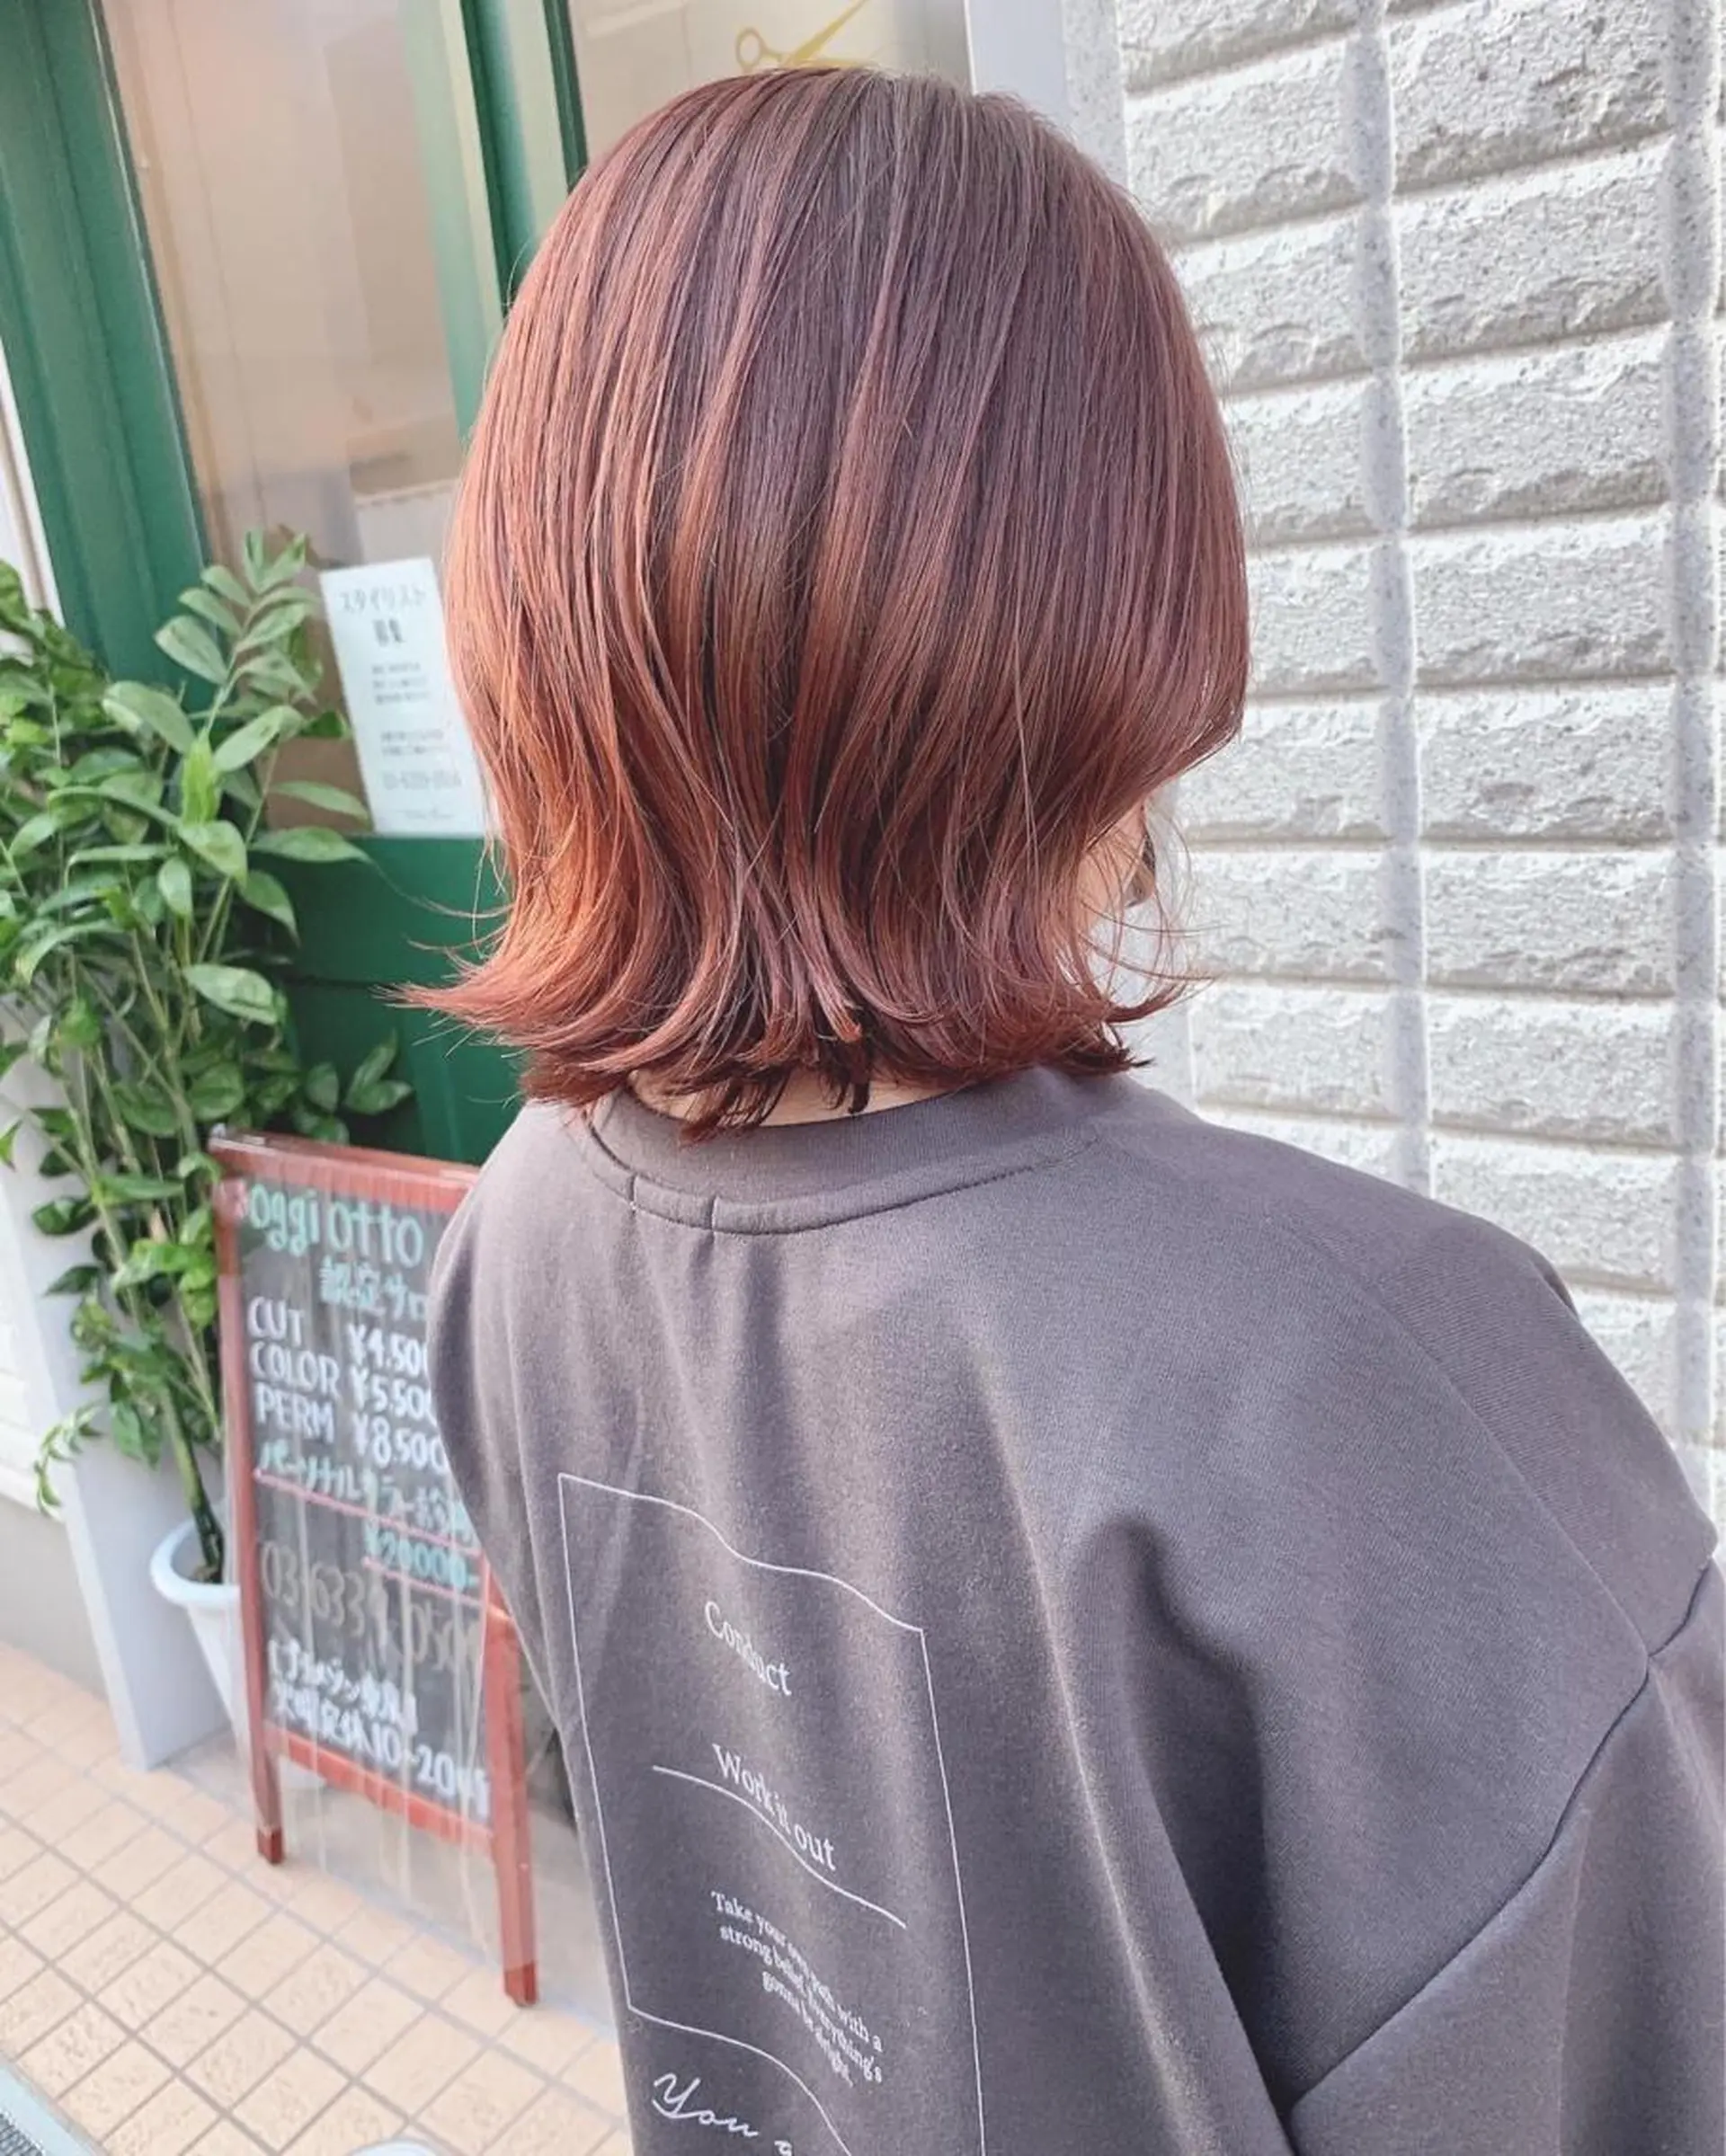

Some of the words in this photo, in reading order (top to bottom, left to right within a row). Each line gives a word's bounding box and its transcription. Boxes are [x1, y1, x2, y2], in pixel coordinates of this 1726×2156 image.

[247, 1296, 306, 1346] CUT
[250, 1341, 339, 1397] COLOR
[255, 1382, 334, 1442] PERM
[794, 1823, 836, 1871] out
[710, 1890, 754, 1923] Take
[755, 1913, 787, 1947] your
[837, 2003, 869, 2043] with
[872, 2035, 884, 2054] a
[720, 1925, 773, 1966] strong
